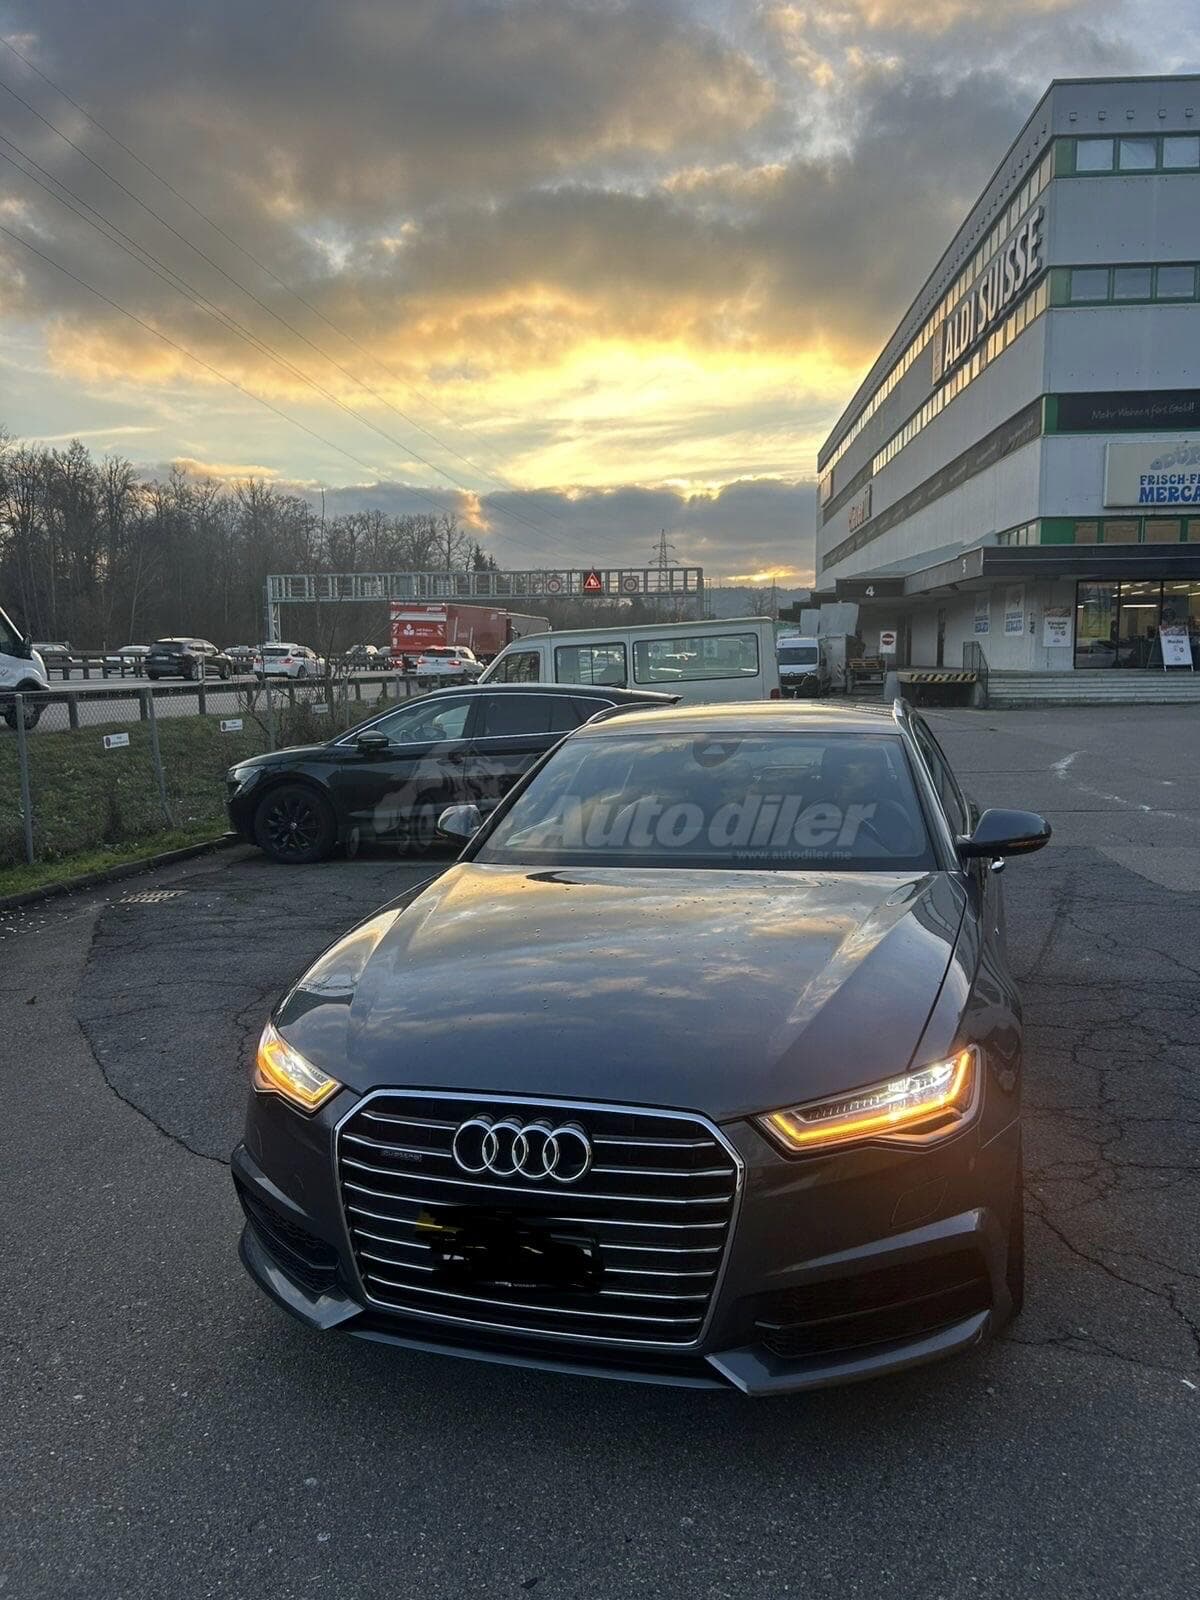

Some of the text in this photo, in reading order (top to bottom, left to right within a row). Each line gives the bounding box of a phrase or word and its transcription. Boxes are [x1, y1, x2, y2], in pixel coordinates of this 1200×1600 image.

[943, 206, 1042, 372] ALDI SUISSE
[865, 585, 875, 597] 4
